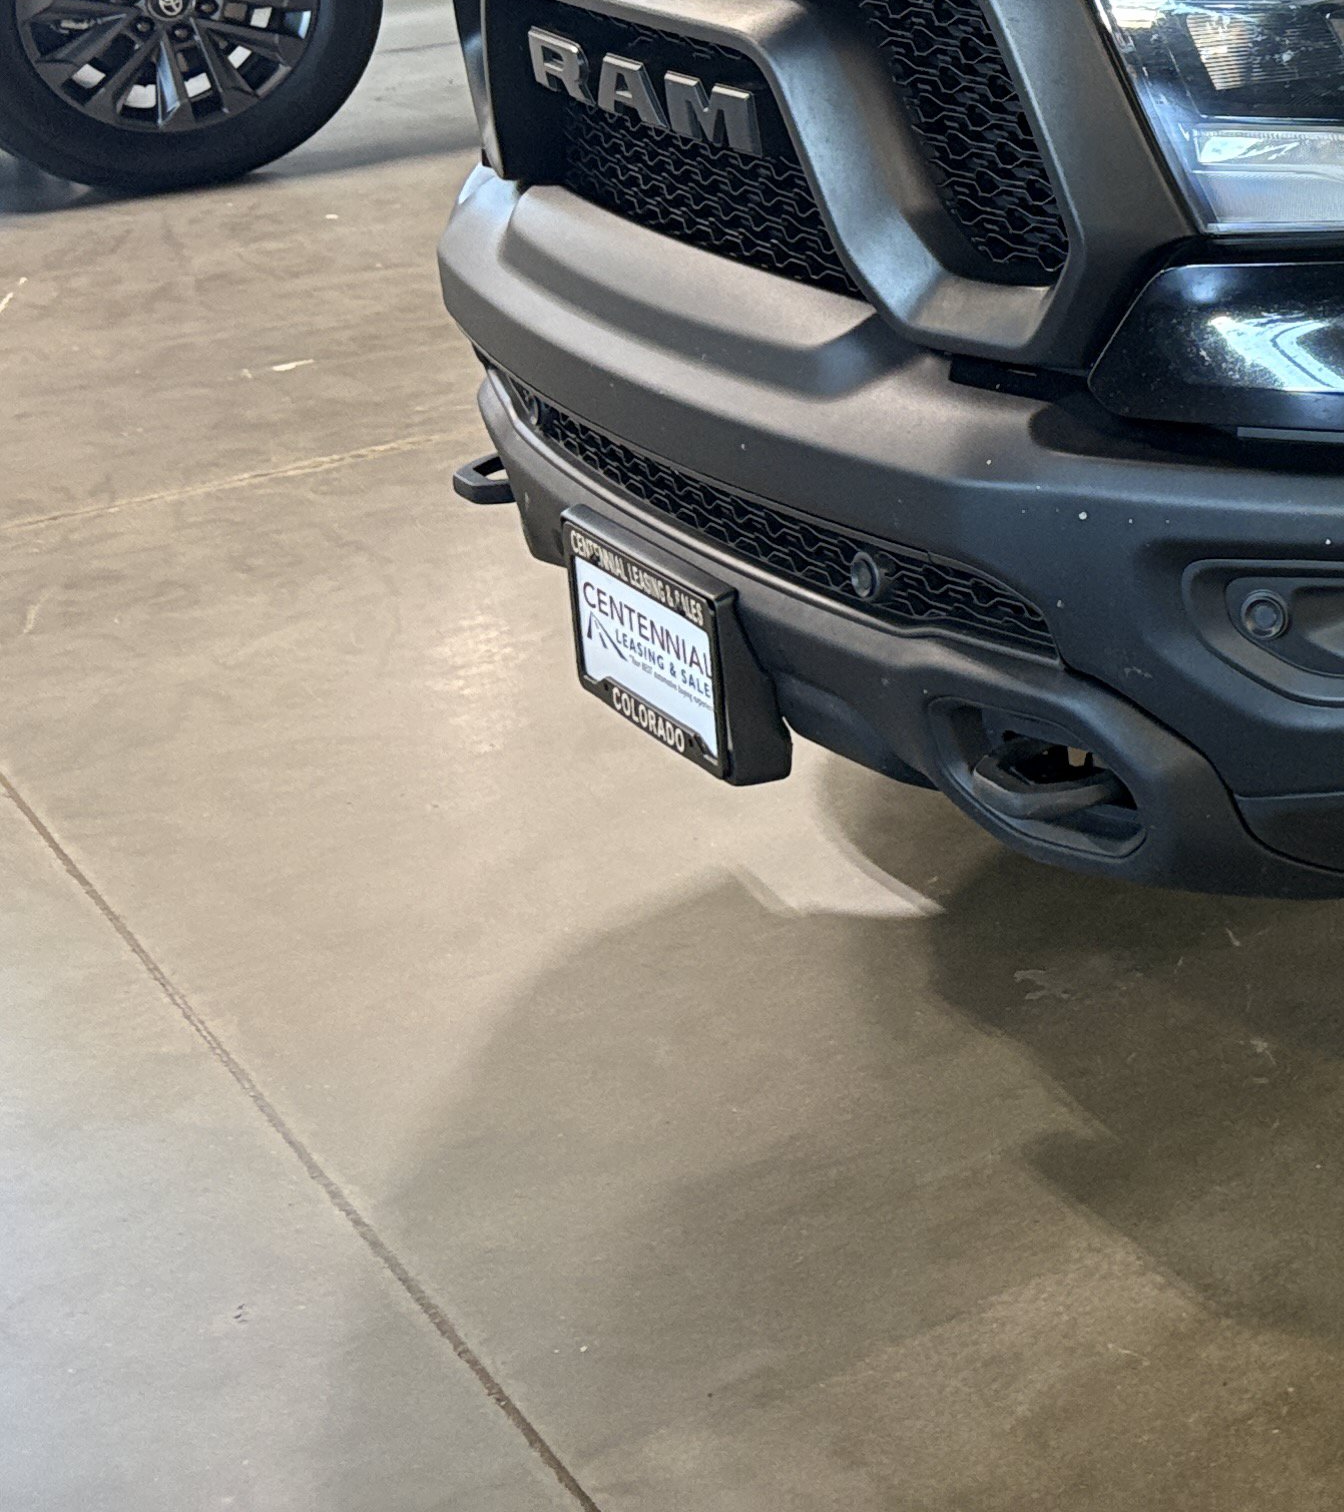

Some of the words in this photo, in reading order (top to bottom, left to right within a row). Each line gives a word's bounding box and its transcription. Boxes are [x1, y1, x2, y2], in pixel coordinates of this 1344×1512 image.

[528, 26, 763, 158] RAM
[583, 581, 713, 680] CENTENNIAL
[615, 628, 665, 671] LEASING
[669, 662, 677, 678] &
[681, 669, 711, 699] SALE
[612, 687, 685, 753] COLORADO
